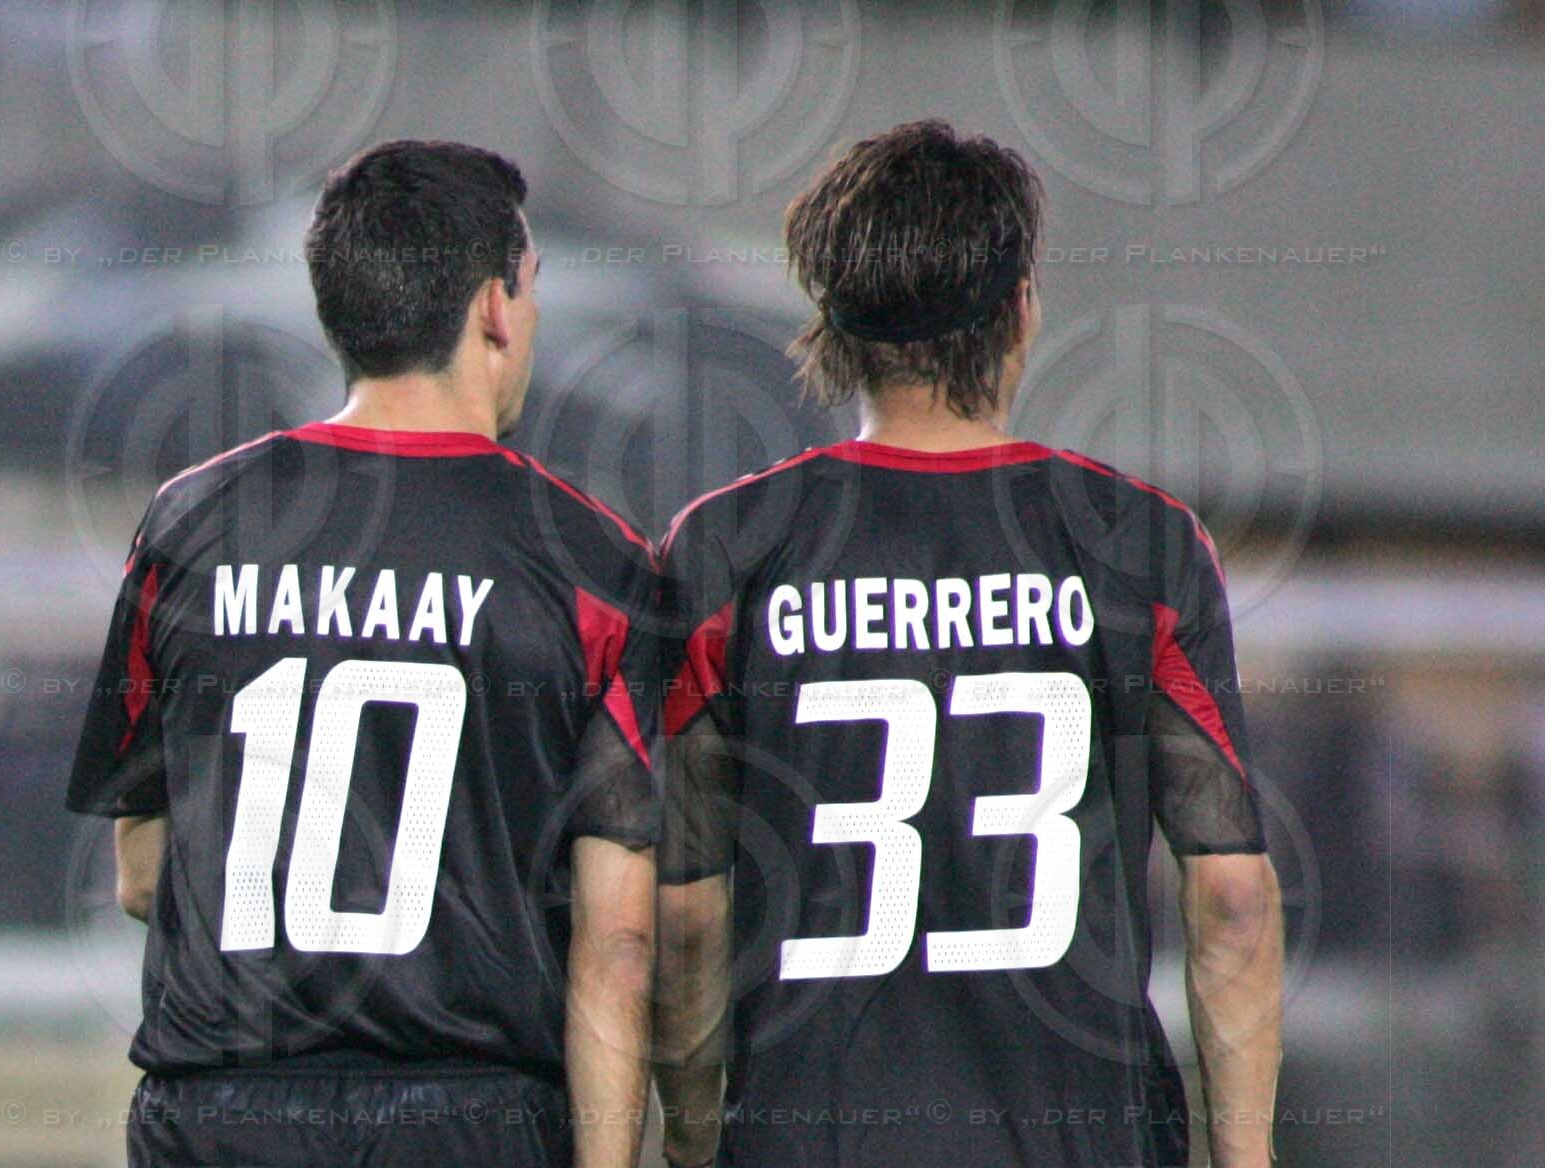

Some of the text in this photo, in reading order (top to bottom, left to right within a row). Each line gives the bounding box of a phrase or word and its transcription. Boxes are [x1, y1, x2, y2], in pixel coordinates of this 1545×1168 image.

[214, 564, 494, 646] MAKAAY
[768, 573, 1094, 655] GUERRERO
[220, 657, 467, 955] 10
[779, 672, 1092, 980] 33
